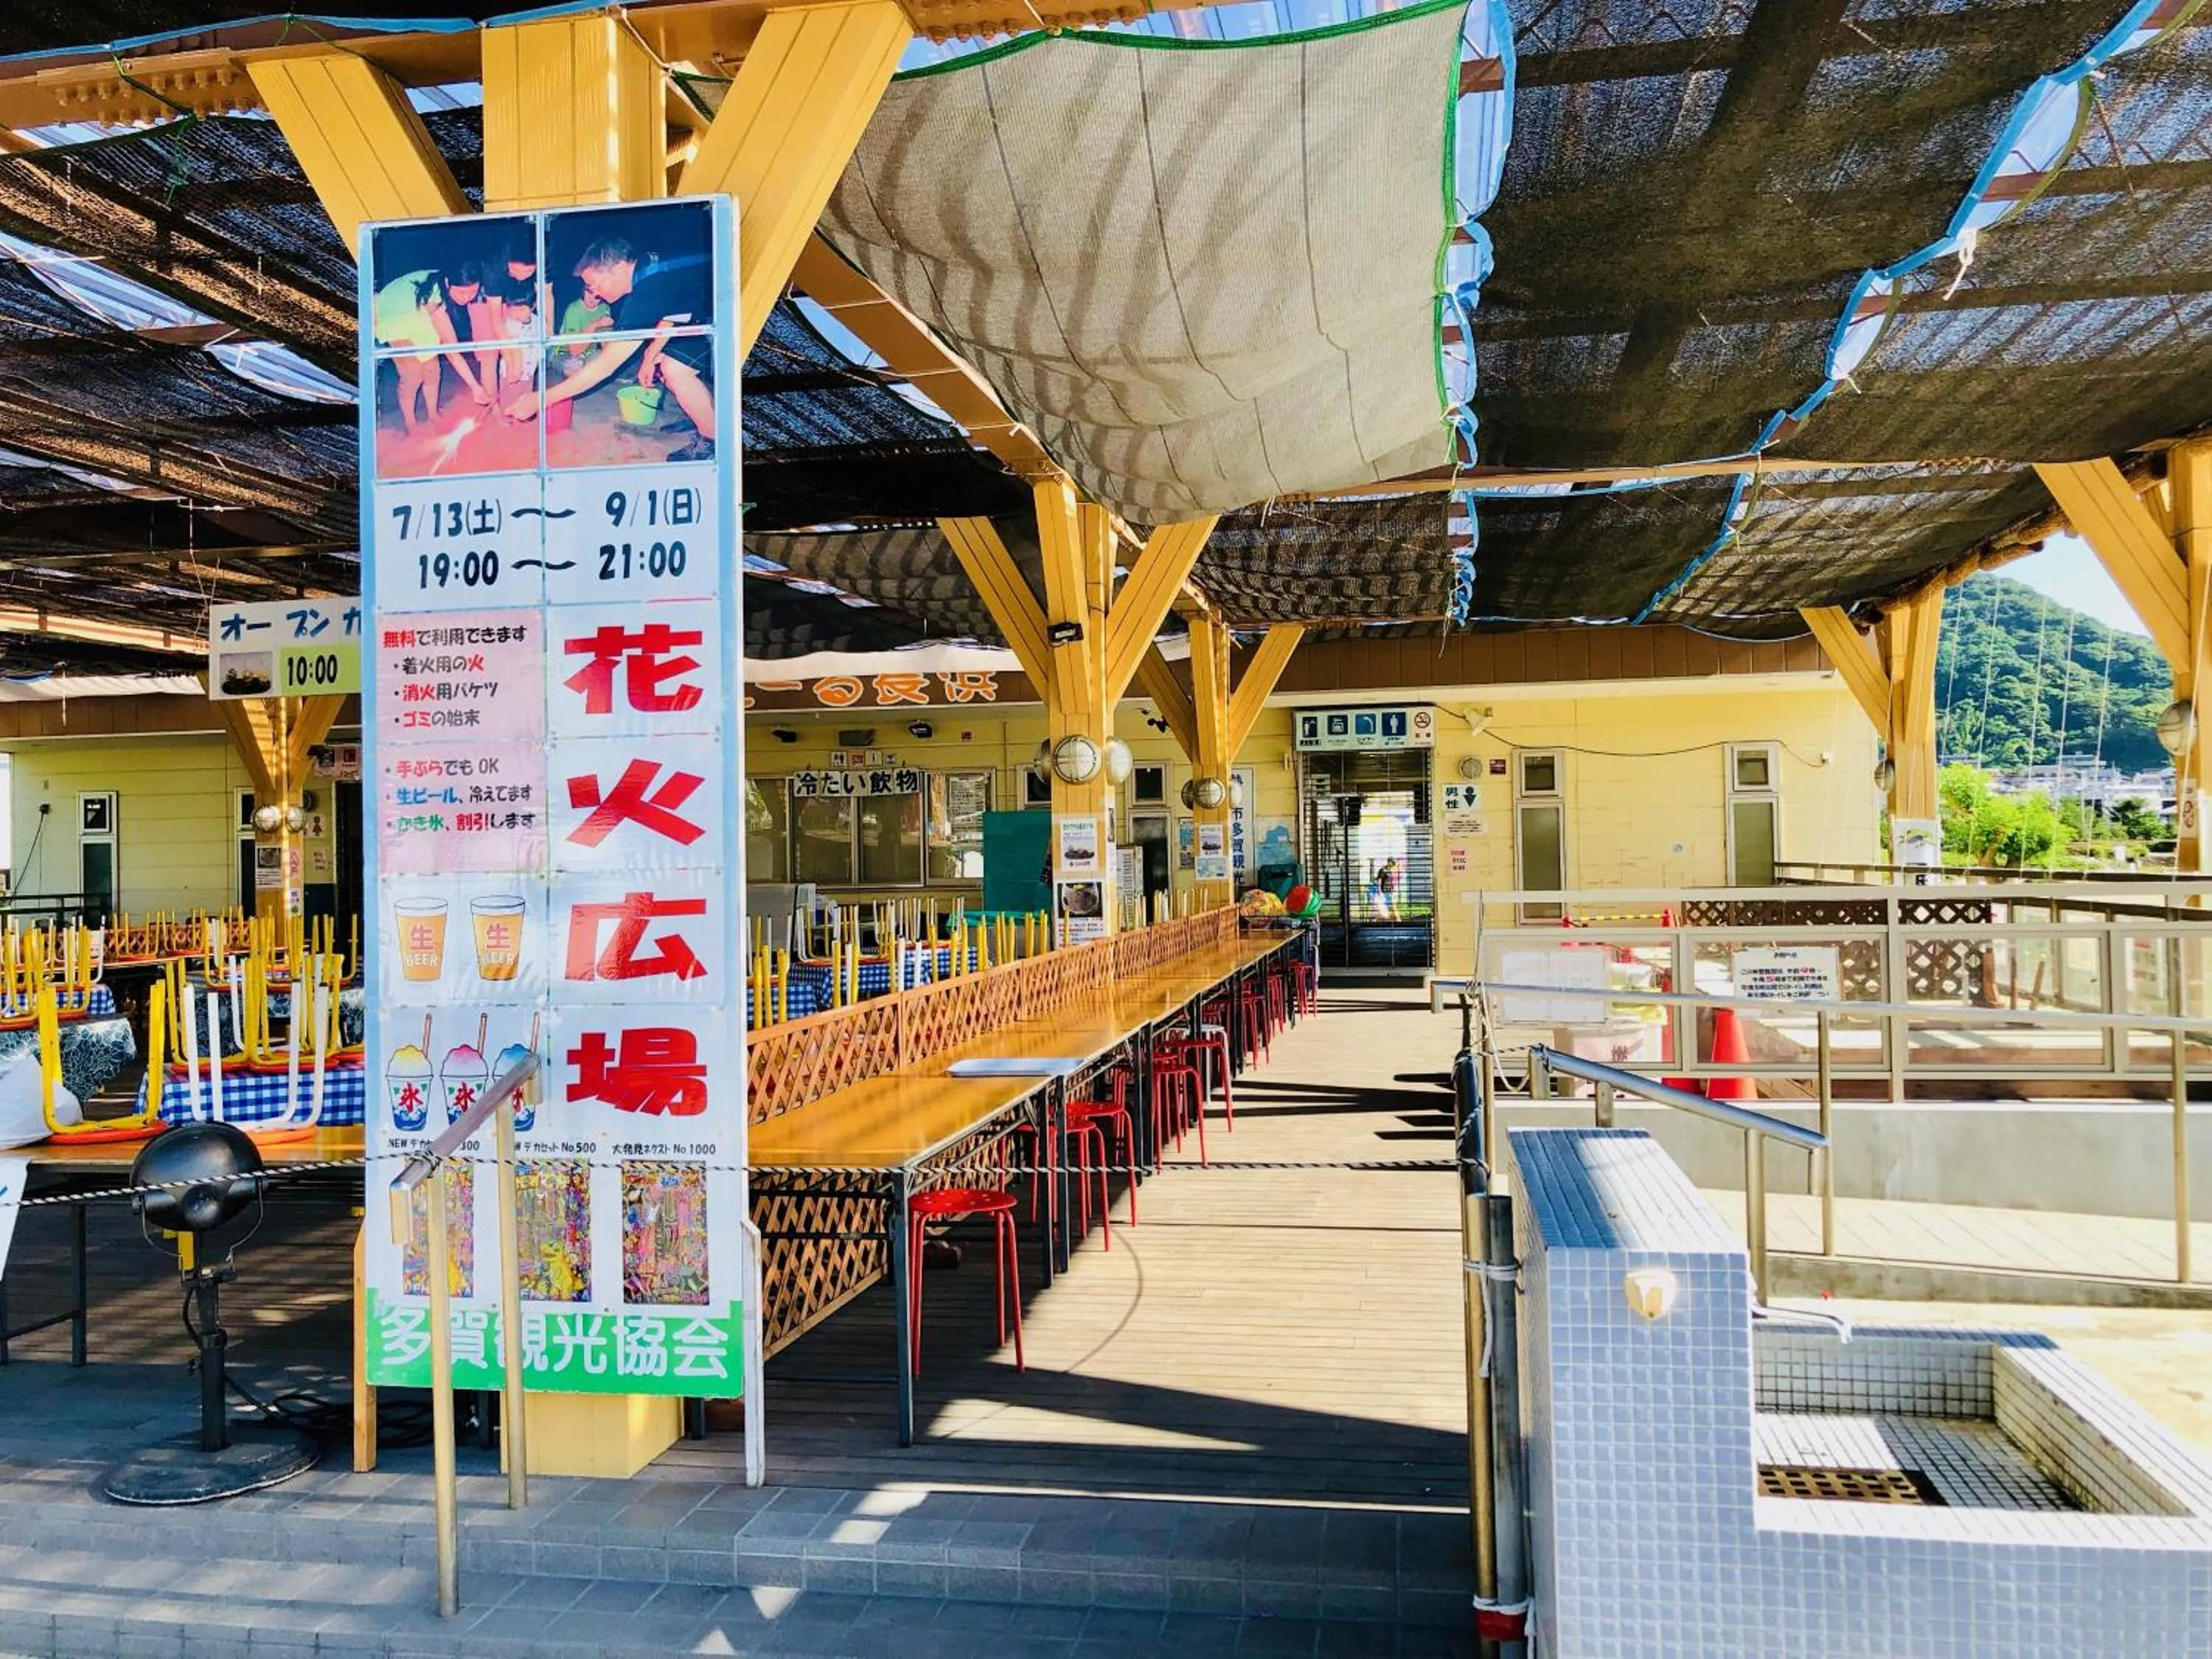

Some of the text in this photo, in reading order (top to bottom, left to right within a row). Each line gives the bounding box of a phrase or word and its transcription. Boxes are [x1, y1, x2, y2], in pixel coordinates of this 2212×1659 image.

[418, 550, 500, 589] 19:00
[599, 540, 687, 580] 21:00
[383, 625, 527, 648] 無料で利用できます
[287, 654, 338, 686] 10:00
[796, 769, 918, 796] 冷たい飲物
[410, 924, 437, 951] 生
[486, 922, 511, 950] 生
[398, 1082, 424, 1113] 氷
[452, 1081, 478, 1113] 氷
